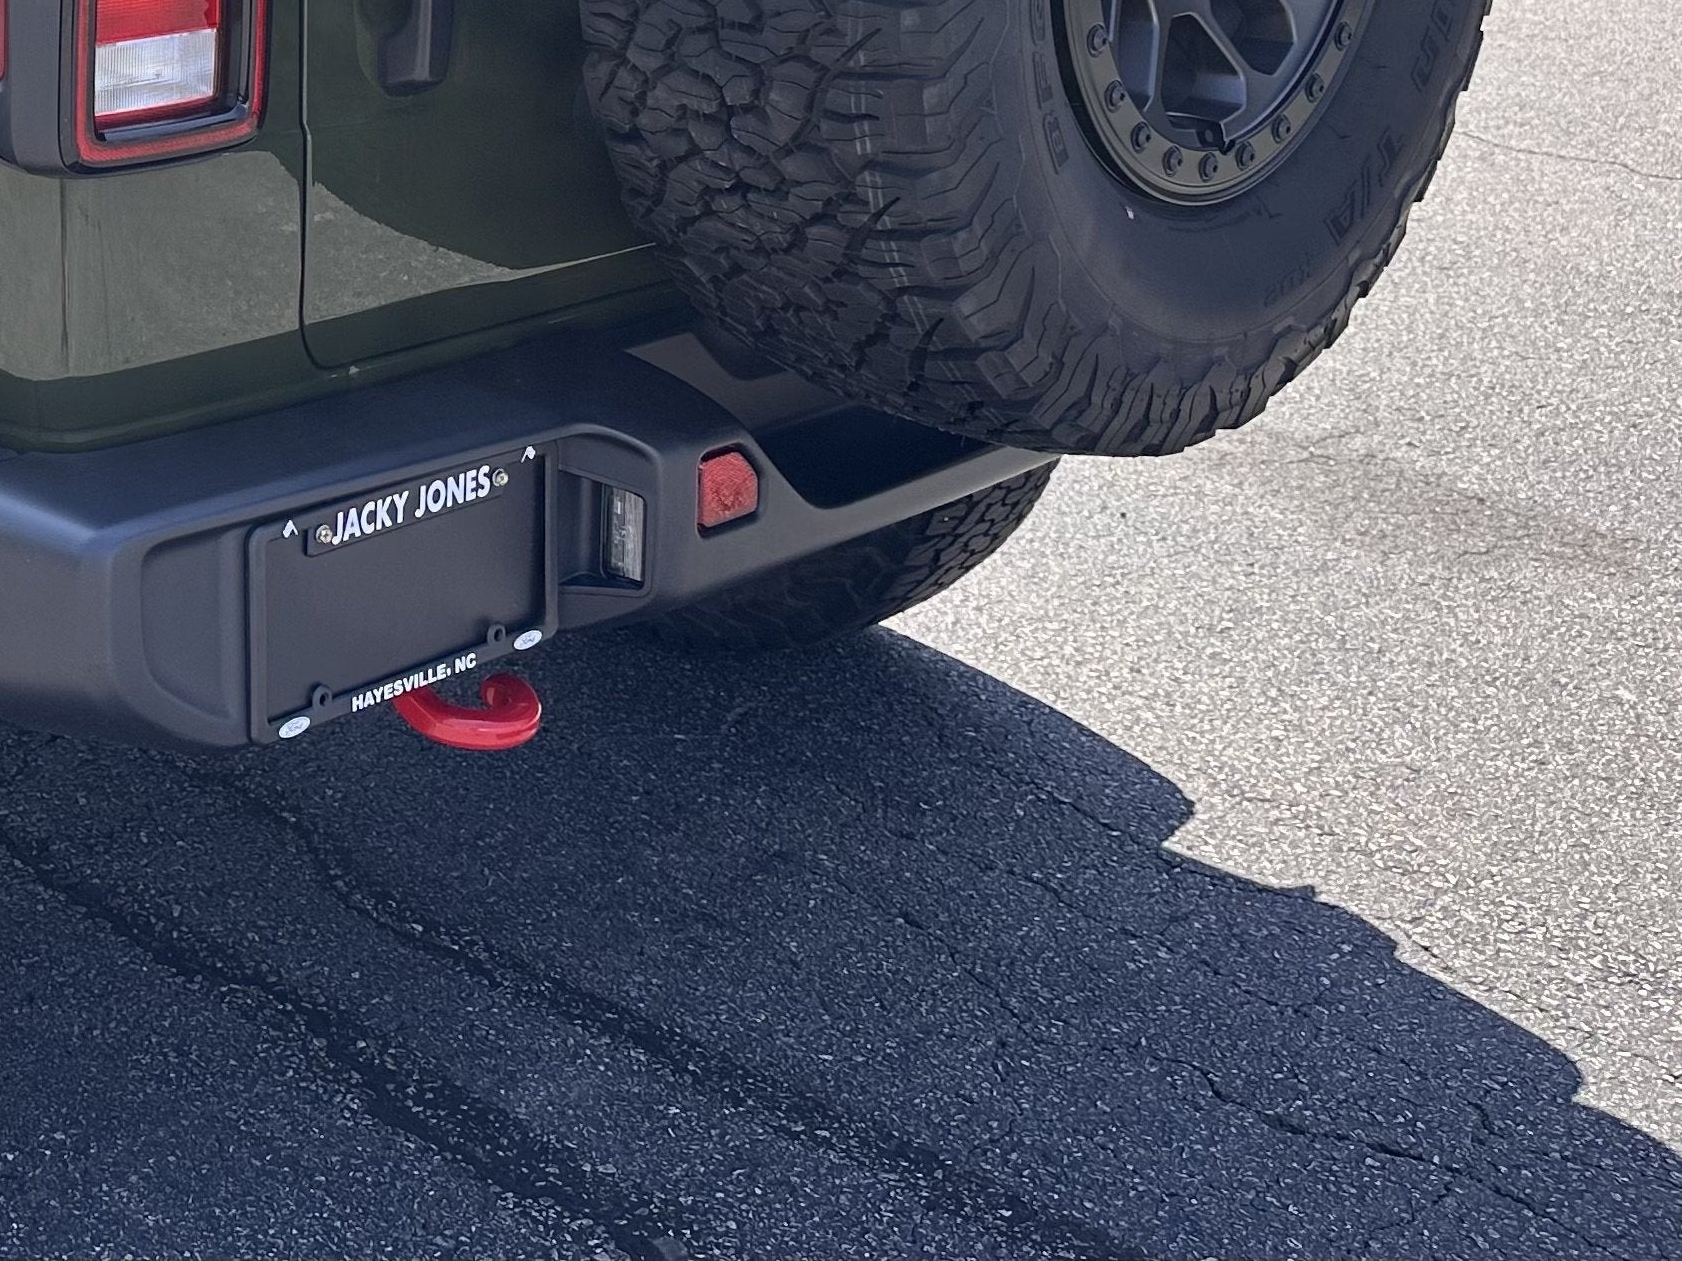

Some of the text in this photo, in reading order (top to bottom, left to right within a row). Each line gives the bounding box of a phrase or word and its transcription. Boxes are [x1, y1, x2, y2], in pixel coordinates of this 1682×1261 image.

[331, 465, 491, 545] JACKY JONES
[351, 652, 477, 712] HAYESVILLE, NC
